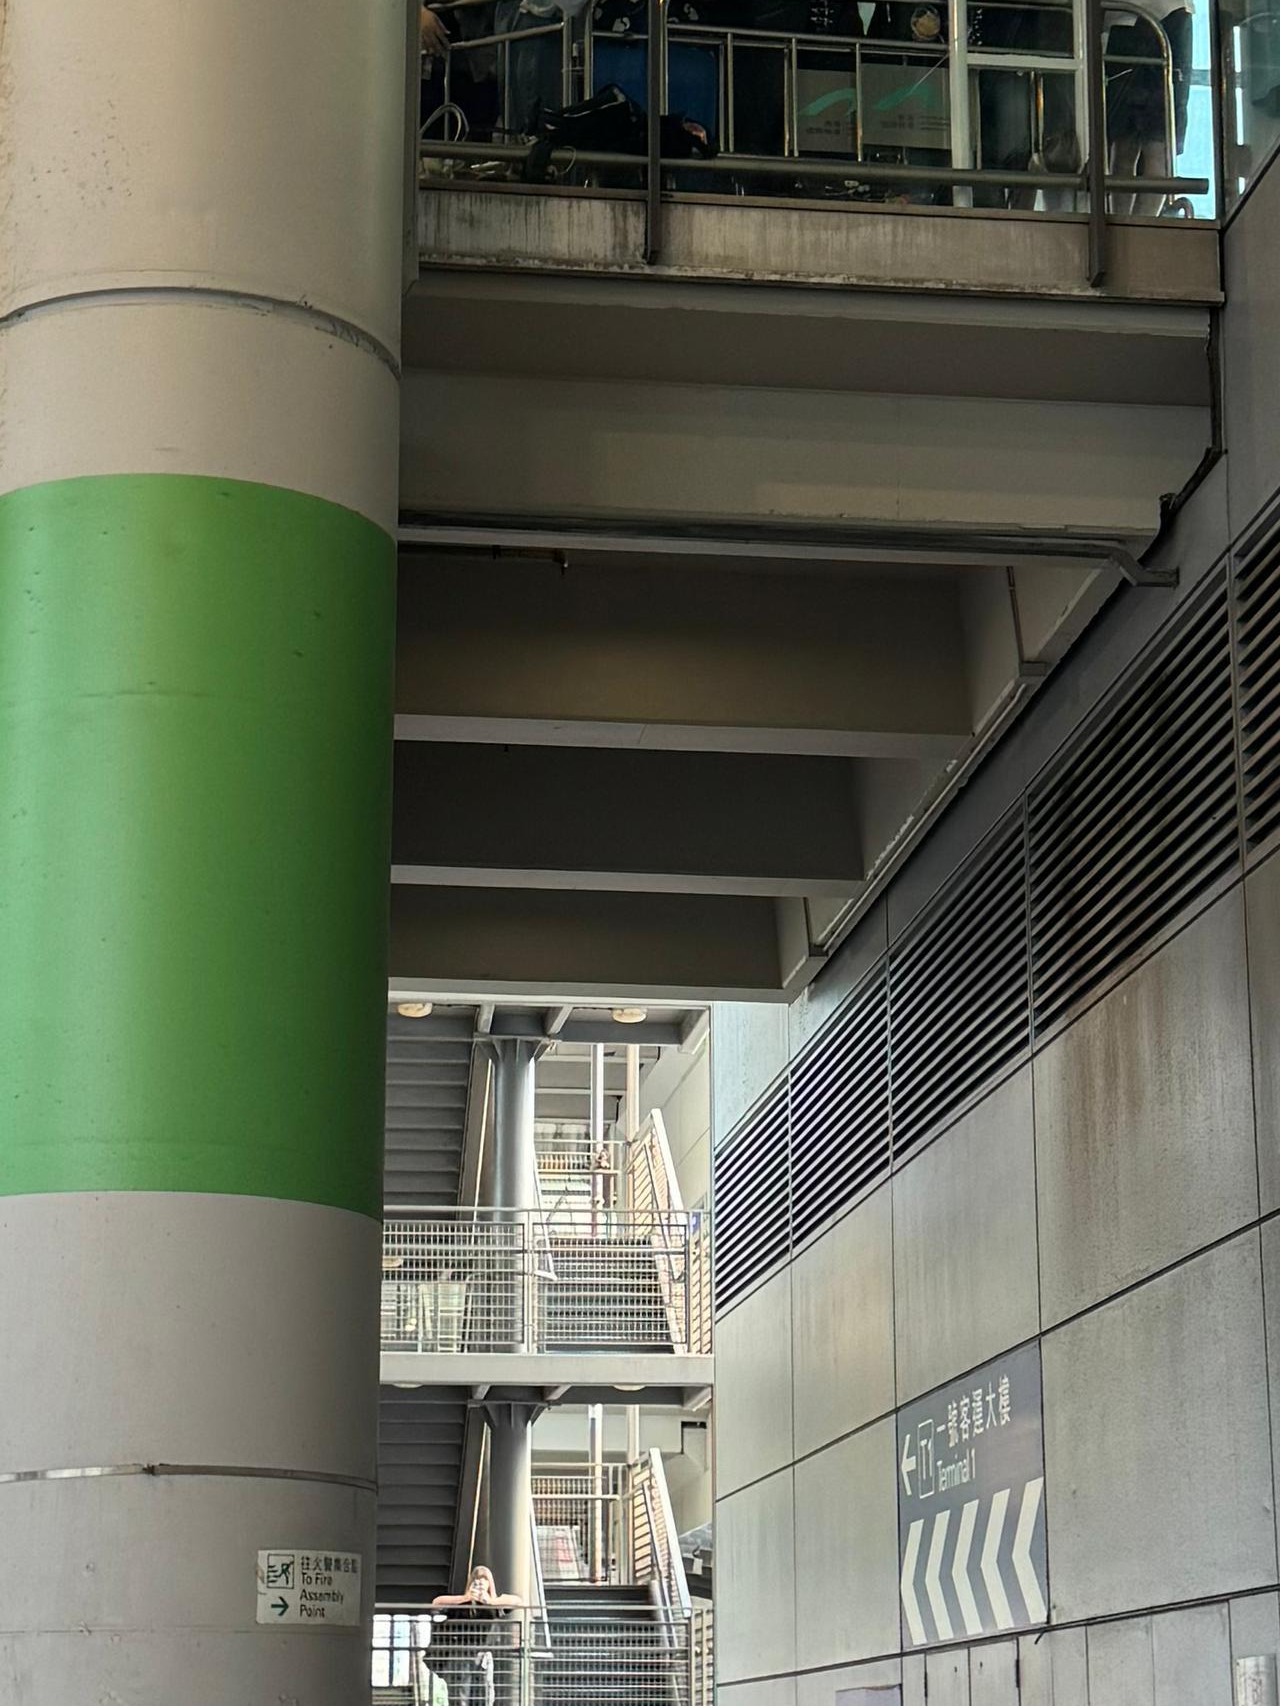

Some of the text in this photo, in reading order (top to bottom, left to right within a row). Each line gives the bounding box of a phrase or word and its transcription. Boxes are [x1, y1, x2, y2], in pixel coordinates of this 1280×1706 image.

[936, 1448, 970, 1492] Terminal
[301, 1572, 333, 1586] To Fire
[300, 1589, 344, 1605] Assembly
[300, 1604, 325, 1618] Point
